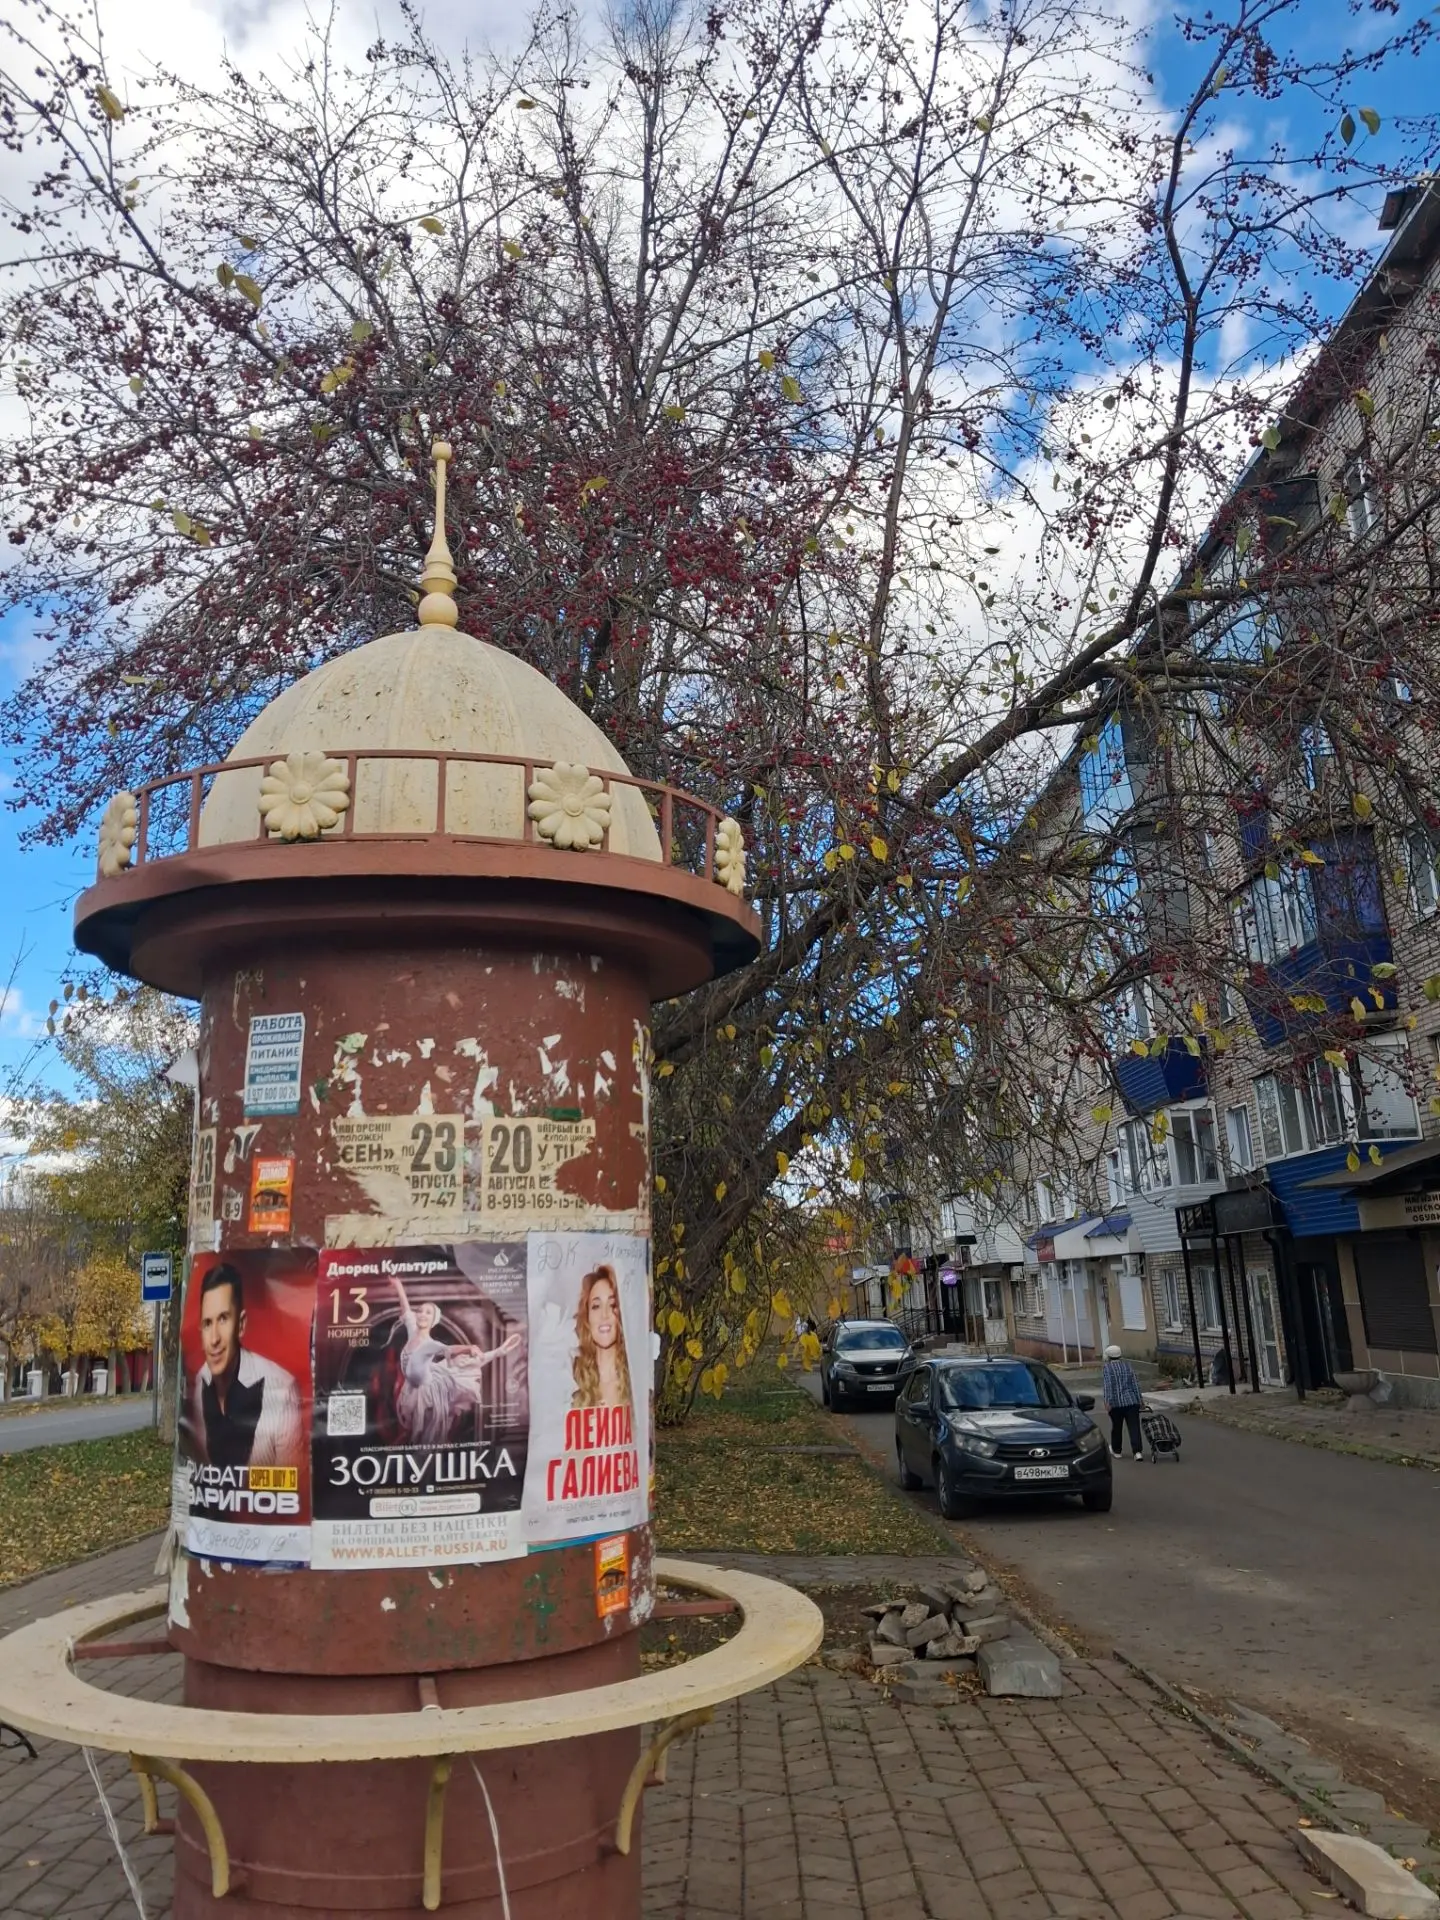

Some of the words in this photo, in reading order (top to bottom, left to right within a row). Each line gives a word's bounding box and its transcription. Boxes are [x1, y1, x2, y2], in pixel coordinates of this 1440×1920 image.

[253, 1015, 303, 1031] РАБОТА
[252, 1031, 301, 1044] ПРОЖИВАНИЕ
[251, 1046, 301, 1060] ПИТАНИЕ
[340, 1144, 395, 1164] СЕН»
[411, 1121, 456, 1173] 23
[490, 1124, 533, 1174] 20
[537, 1144, 548, 1162] У
[404, 1174, 457, 1190] ВГУСТА
[488, 1175, 536, 1190] АВГУСТА
[1404, 1193, 1440, 1205] МАГАЗИ
[326, 1261, 380, 1278] Дворец
[381, 1258, 449, 1276] Культуры
[329, 1287, 371, 1325] 13
[327, 1327, 370, 1339] НОЯБРЯ
[348, 1337, 370, 1348] 18:00
[564, 1401, 633, 1452] ЛЕЙЛА
[329, 1447, 518, 1486] ЗОЛУШКА
[546, 1449, 640, 1502] ГАЛИЕВА
[331, 1521, 395, 1536] БИЛЕТЫ
[400, 1520, 428, 1534] БЕЗ
[433, 1514, 508, 1533] НАЦЕНКИ
[331, 1539, 508, 1560] WWW.BALLET-RUSSIA.RU
